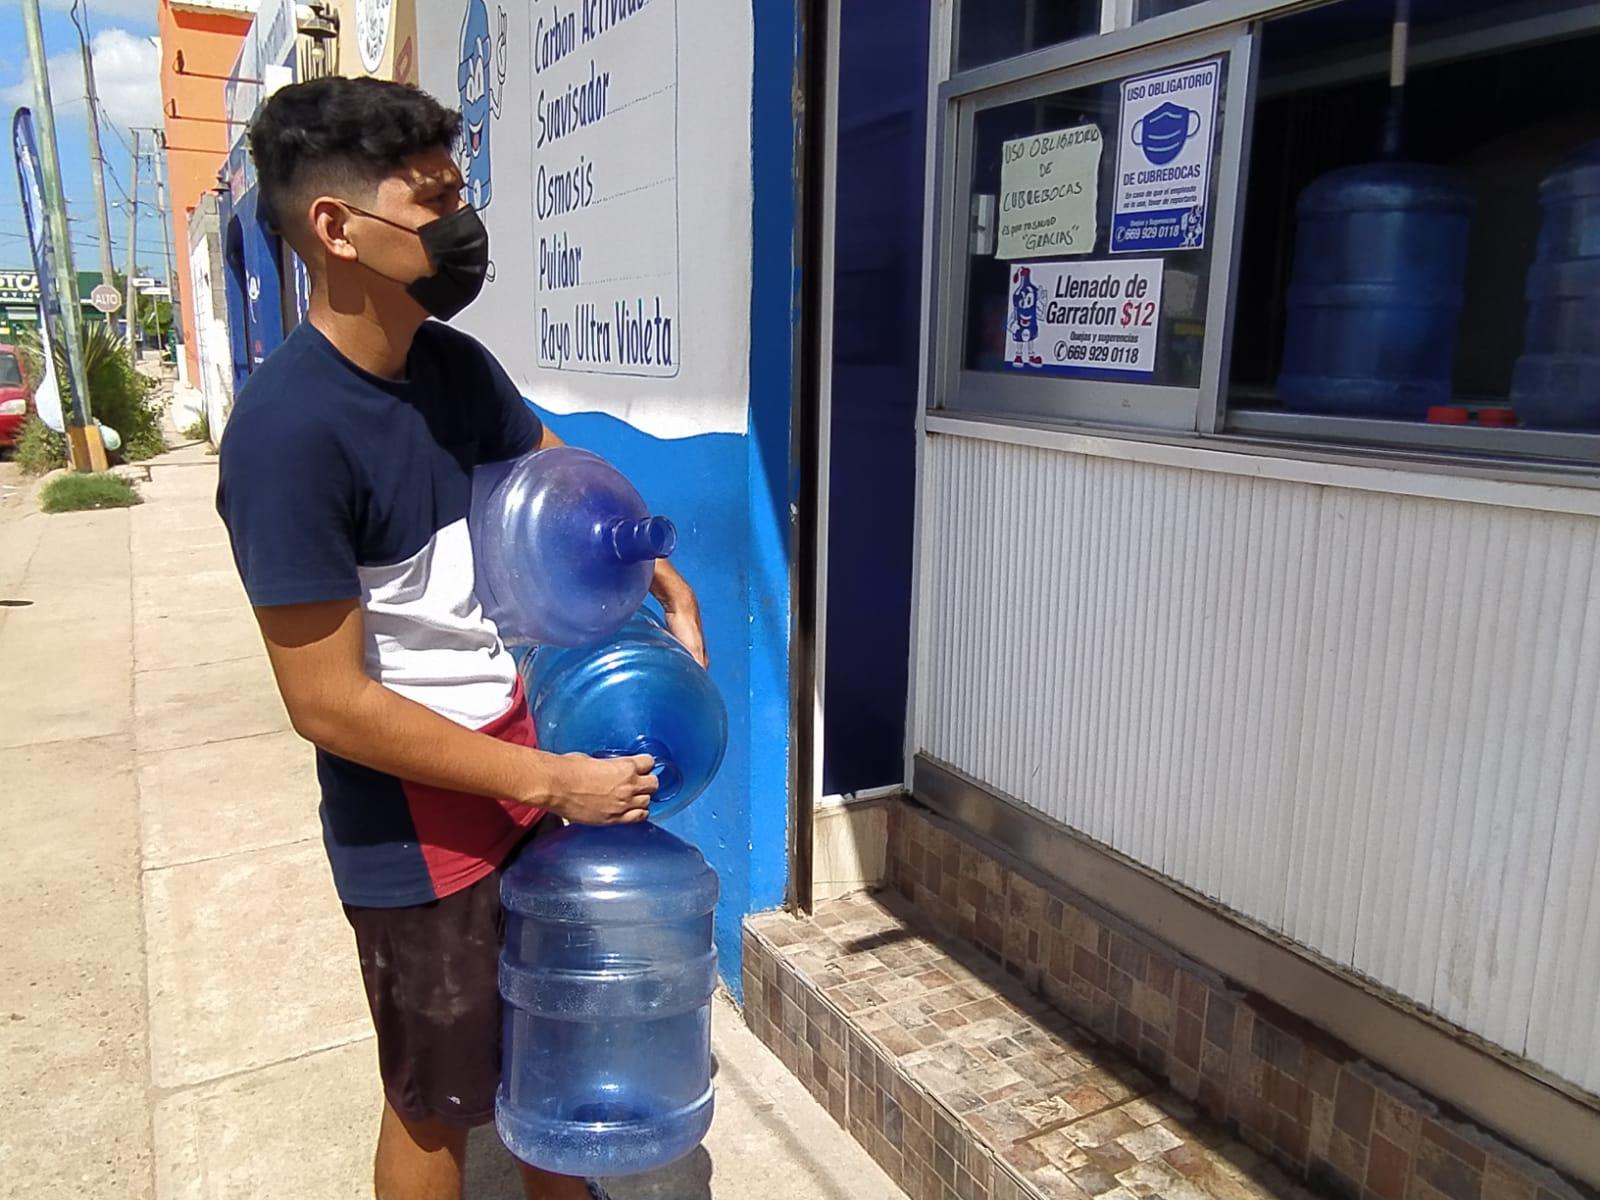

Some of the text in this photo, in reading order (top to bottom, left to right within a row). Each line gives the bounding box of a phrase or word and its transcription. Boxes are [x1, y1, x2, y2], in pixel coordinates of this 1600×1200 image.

[534, 0, 645, 74] Carbon Activa
[1127, 71, 1213, 101] USO OBLIGATORIO
[536, 58, 610, 149] Suavisador
[1005, 143, 1025, 164] USO
[1039, 162, 1054, 177] DE
[1123, 164, 1201, 186] DE CUBREBOCAS
[536, 155, 593, 220] Osmosis
[1003, 182, 1082, 212] CUBREBOCAS
[1125, 225, 1180, 240] 669 929 0118
[539, 231, 582, 291] Pulidor
[95, 293, 118, 305] ALTO
[1055, 273, 1148, 299] Llenado de
[1046, 300, 1156, 329] Garrafon $12
[541, 296, 673, 370] Rayo Ultra Violeta
[1070, 331, 1091, 342] Quejas
[1067, 345, 1139, 365] 669 929 0118
